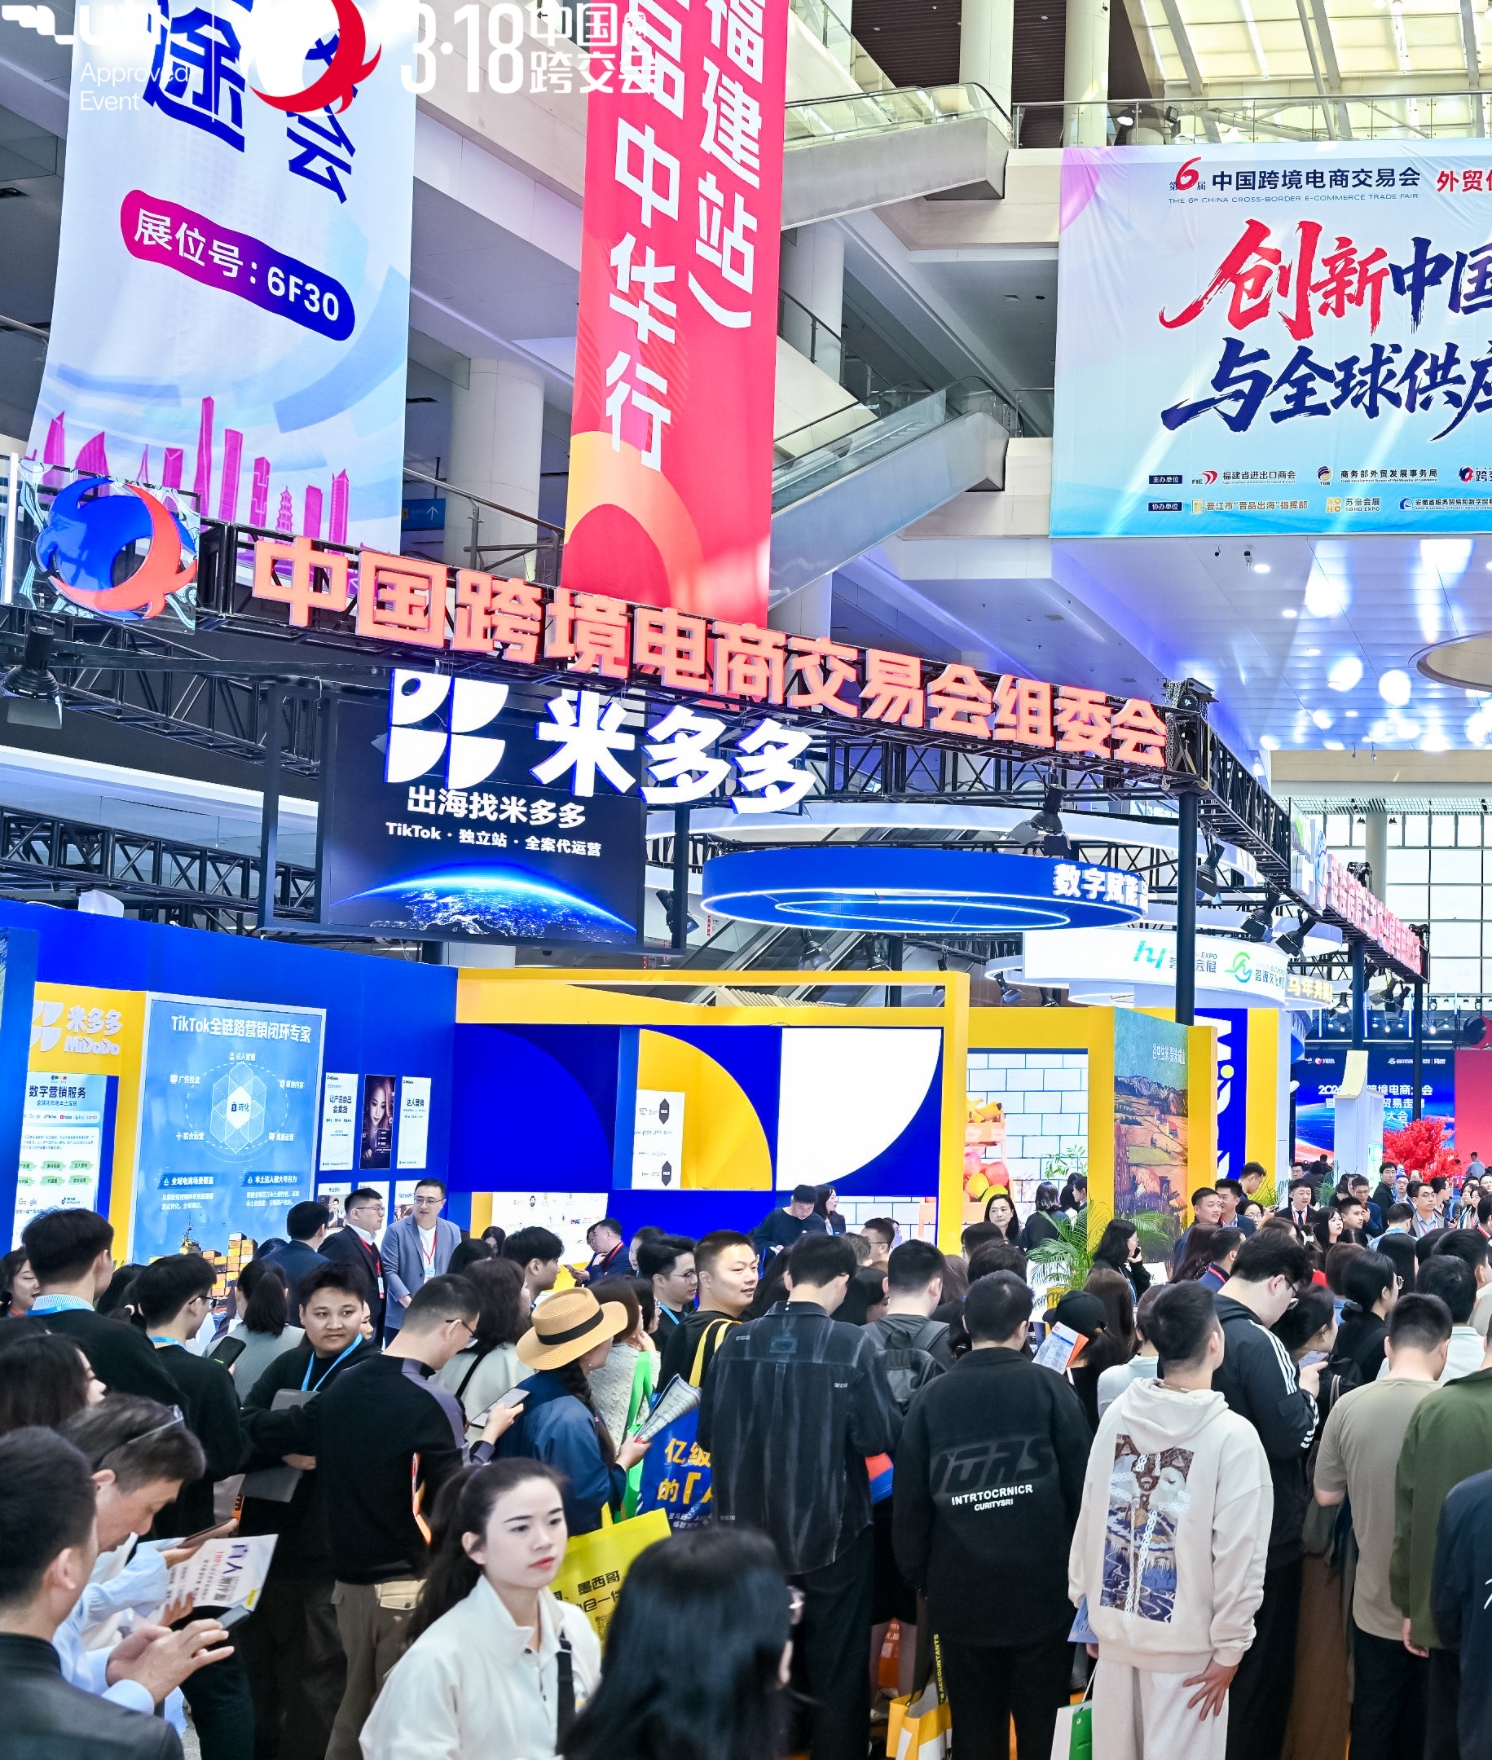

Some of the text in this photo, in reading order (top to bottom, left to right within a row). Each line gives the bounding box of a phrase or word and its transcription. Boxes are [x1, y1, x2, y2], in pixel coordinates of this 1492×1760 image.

[1212, 167, 1421, 192] 中国跨境电商交易会
[1232, 195, 1301, 203] CROSS-BORDER
[1305, 194, 1366, 202] E-COMMERCE
[1222, 470, 1296, 480] 福建省进出口商会
[1340, 468, 1438, 479] 商务部外贸发展事务局
[251, 537, 1168, 769] 中国跨境电商交易会组委会
[530, 689, 817, 814] 米多多
[406, 785, 586, 829] 出海找米多多
[385, 822, 602, 857] TikTok 独立站 全案代运营
[66, 1006, 123, 1036] 米多多
[172, 1015, 311, 1044] TikTok全链路营销闭环专家
[64, 1036, 121, 1056] MiDoDo
[29, 1085, 86, 1099] 数字营销服务
